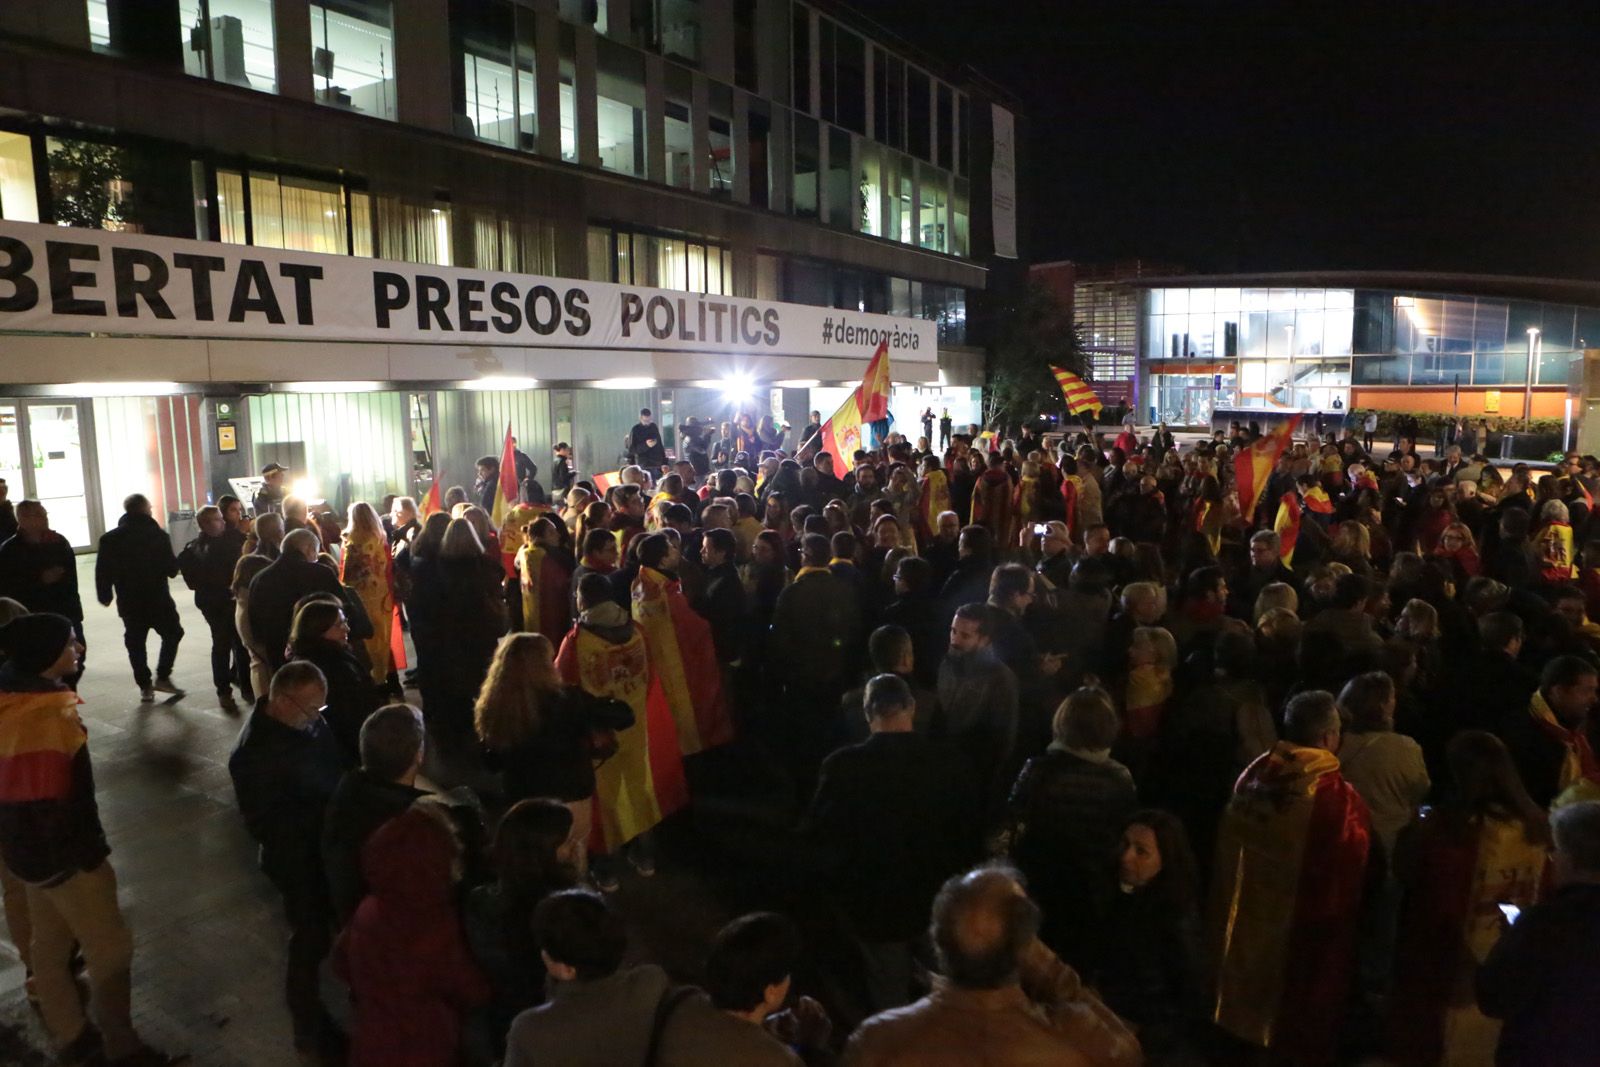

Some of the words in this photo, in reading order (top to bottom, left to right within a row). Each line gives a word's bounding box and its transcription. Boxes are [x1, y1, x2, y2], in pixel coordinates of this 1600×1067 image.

[0, 236, 324, 326] BERTAT
[373, 271, 591, 337] PRESOS
[621, 293, 781, 347] POLÍTICS
